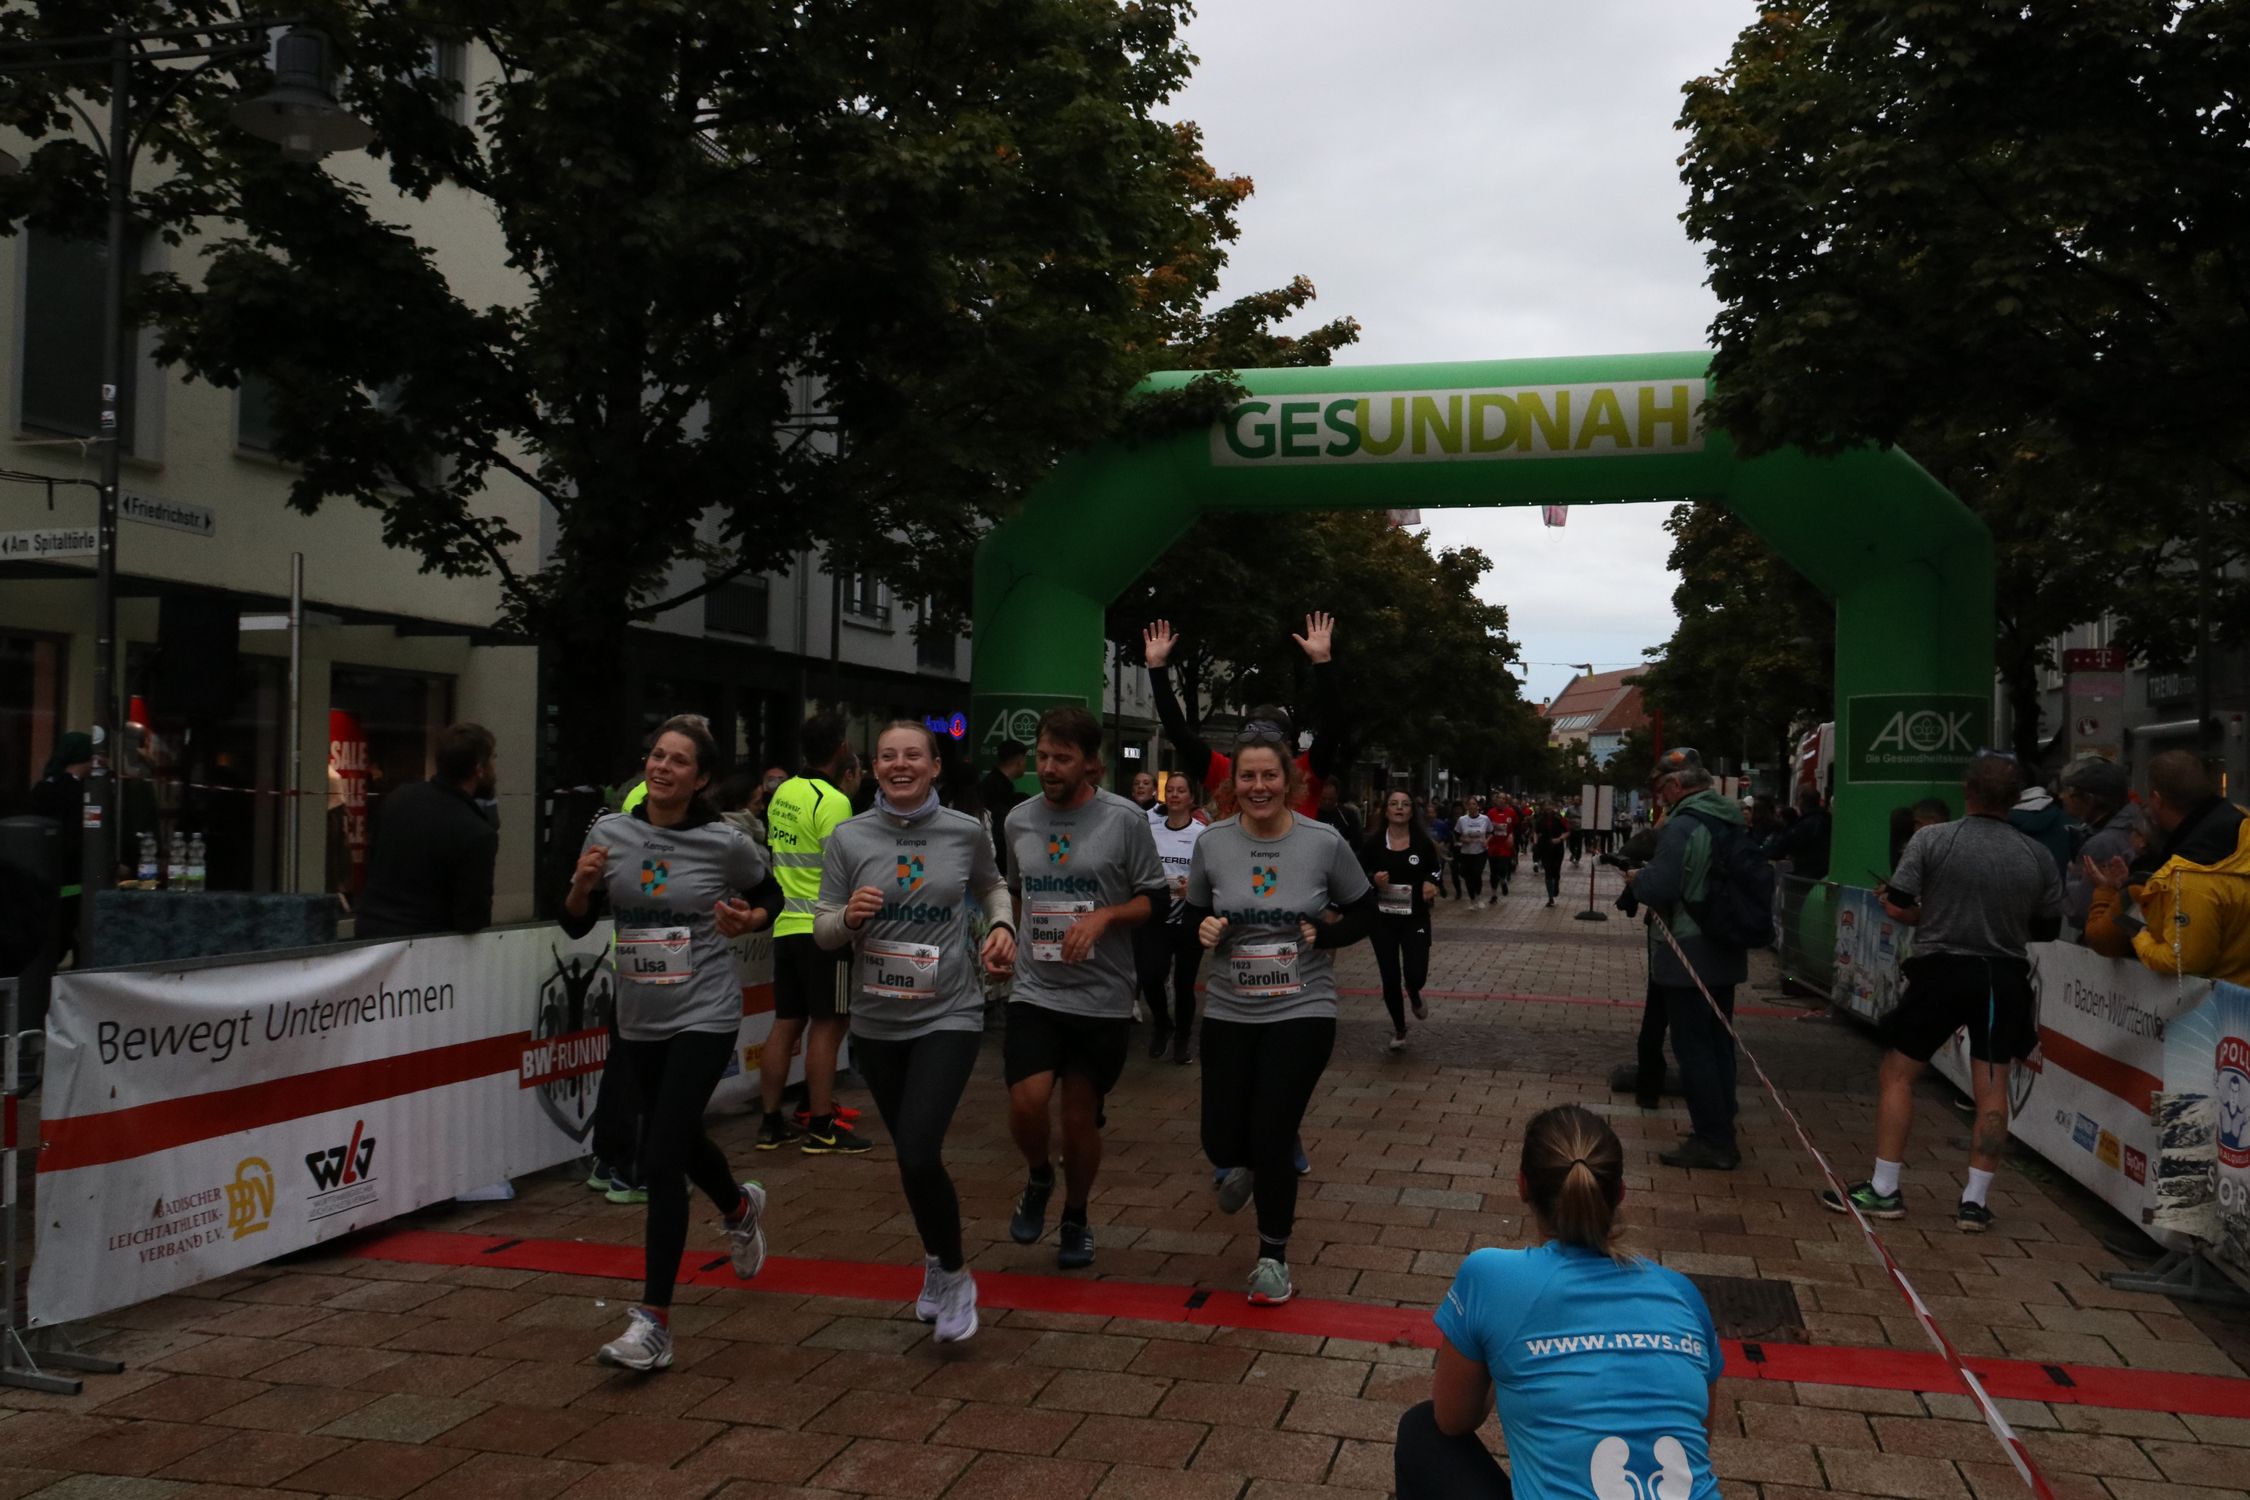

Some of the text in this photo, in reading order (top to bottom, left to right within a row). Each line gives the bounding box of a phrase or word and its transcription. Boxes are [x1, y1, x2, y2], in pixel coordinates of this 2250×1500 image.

[1225, 385, 1690, 459] GESUNDNAH
[131, 498, 202, 527] Friedrichstr.
[11, 532, 95, 555] Am Spitaltörle
[982, 708, 1045, 746] AO
[1868, 710, 1974, 752] AOK
[331, 740, 368, 771] SALE
[1024, 875, 1099, 894] Balingen
[873, 902, 952, 924] alingen
[1032, 927, 1065, 943] Benja
[634, 957, 667, 973] Lisa
[1232, 960, 1251, 970] 1623
[878, 970, 915, 988] Lena
[1238, 970, 1290, 986] Carolin
[2063, 981, 2072, 1005] in
[97, 981, 455, 1064] Bewegt Unternehmen
[108, 1211, 225, 1251] LEICHTATHLETIK-
[139, 1234, 204, 1264] VERBAND
[1526, 1332, 1702, 1357] www.nzvs.de
